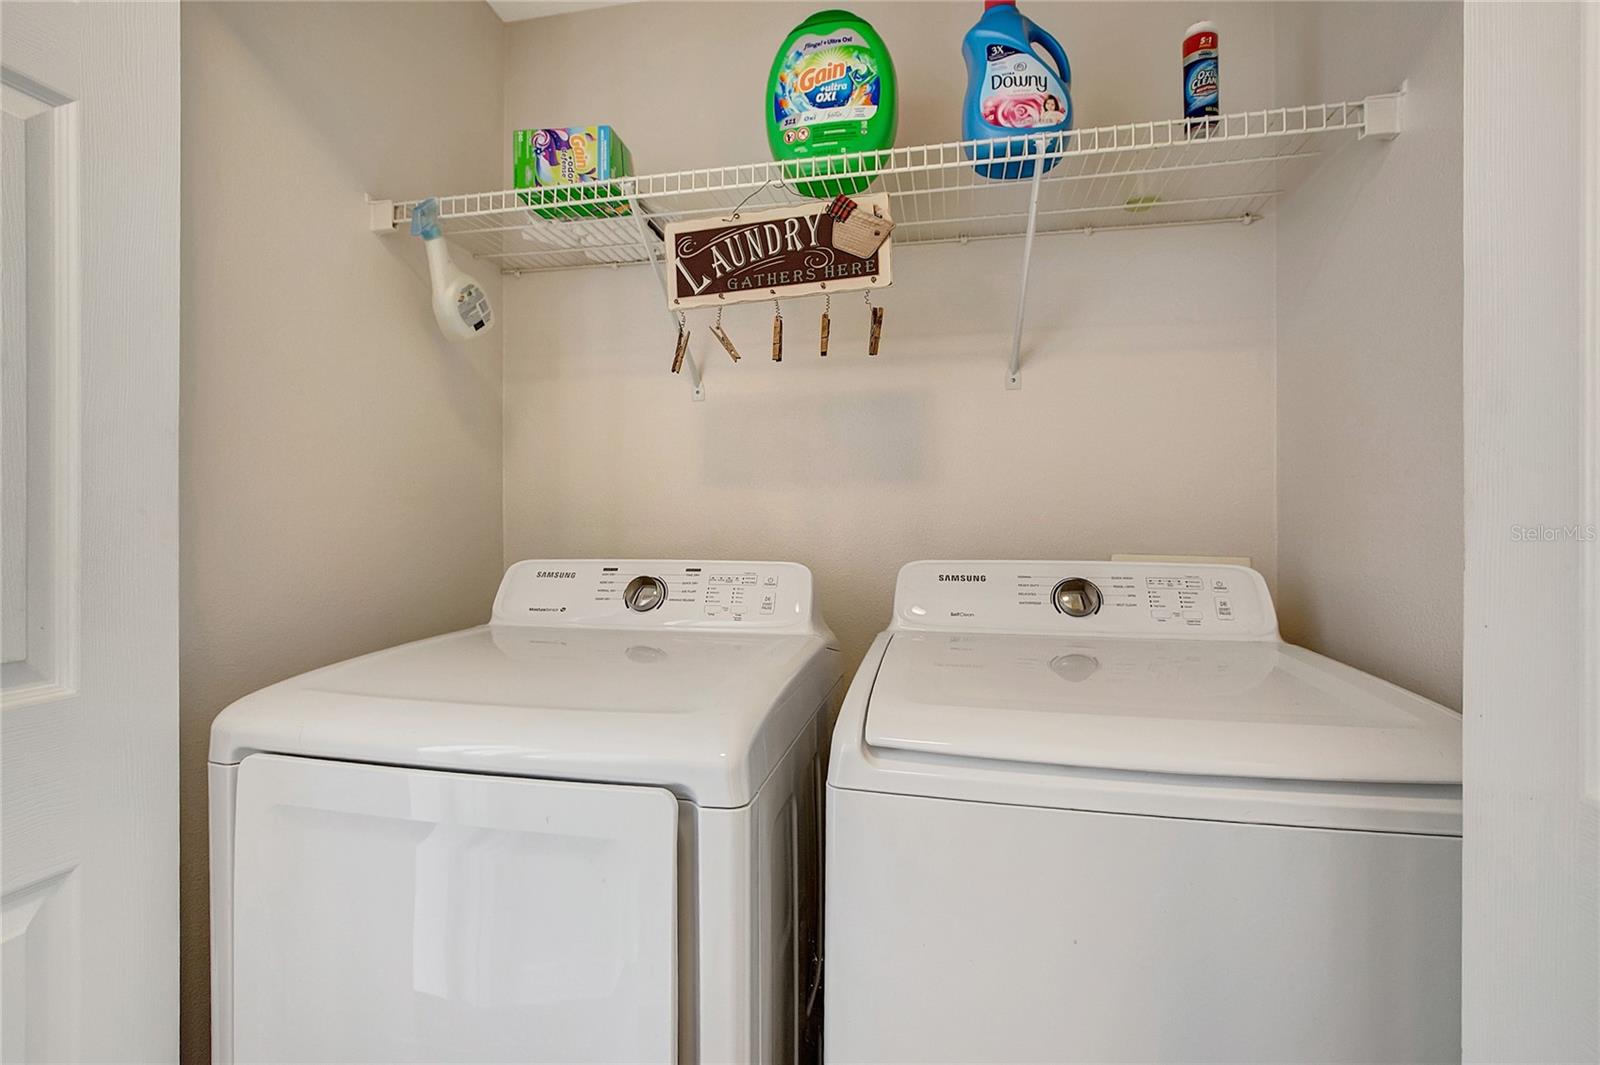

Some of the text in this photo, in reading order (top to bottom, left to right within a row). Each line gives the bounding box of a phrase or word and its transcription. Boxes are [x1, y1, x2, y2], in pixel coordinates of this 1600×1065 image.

[991, 45, 1004, 56] 3X
[799, 62, 846, 92] Gain
[991, 74, 1048, 93] Downy
[570, 135, 587, 169] Gain
[675, 209, 825, 296] LAUNDRY
[726, 259, 876, 290] GATHERS HERE
[536, 571, 577, 579] SAMSUNG
[938, 574, 986, 582] SAMSUNG
